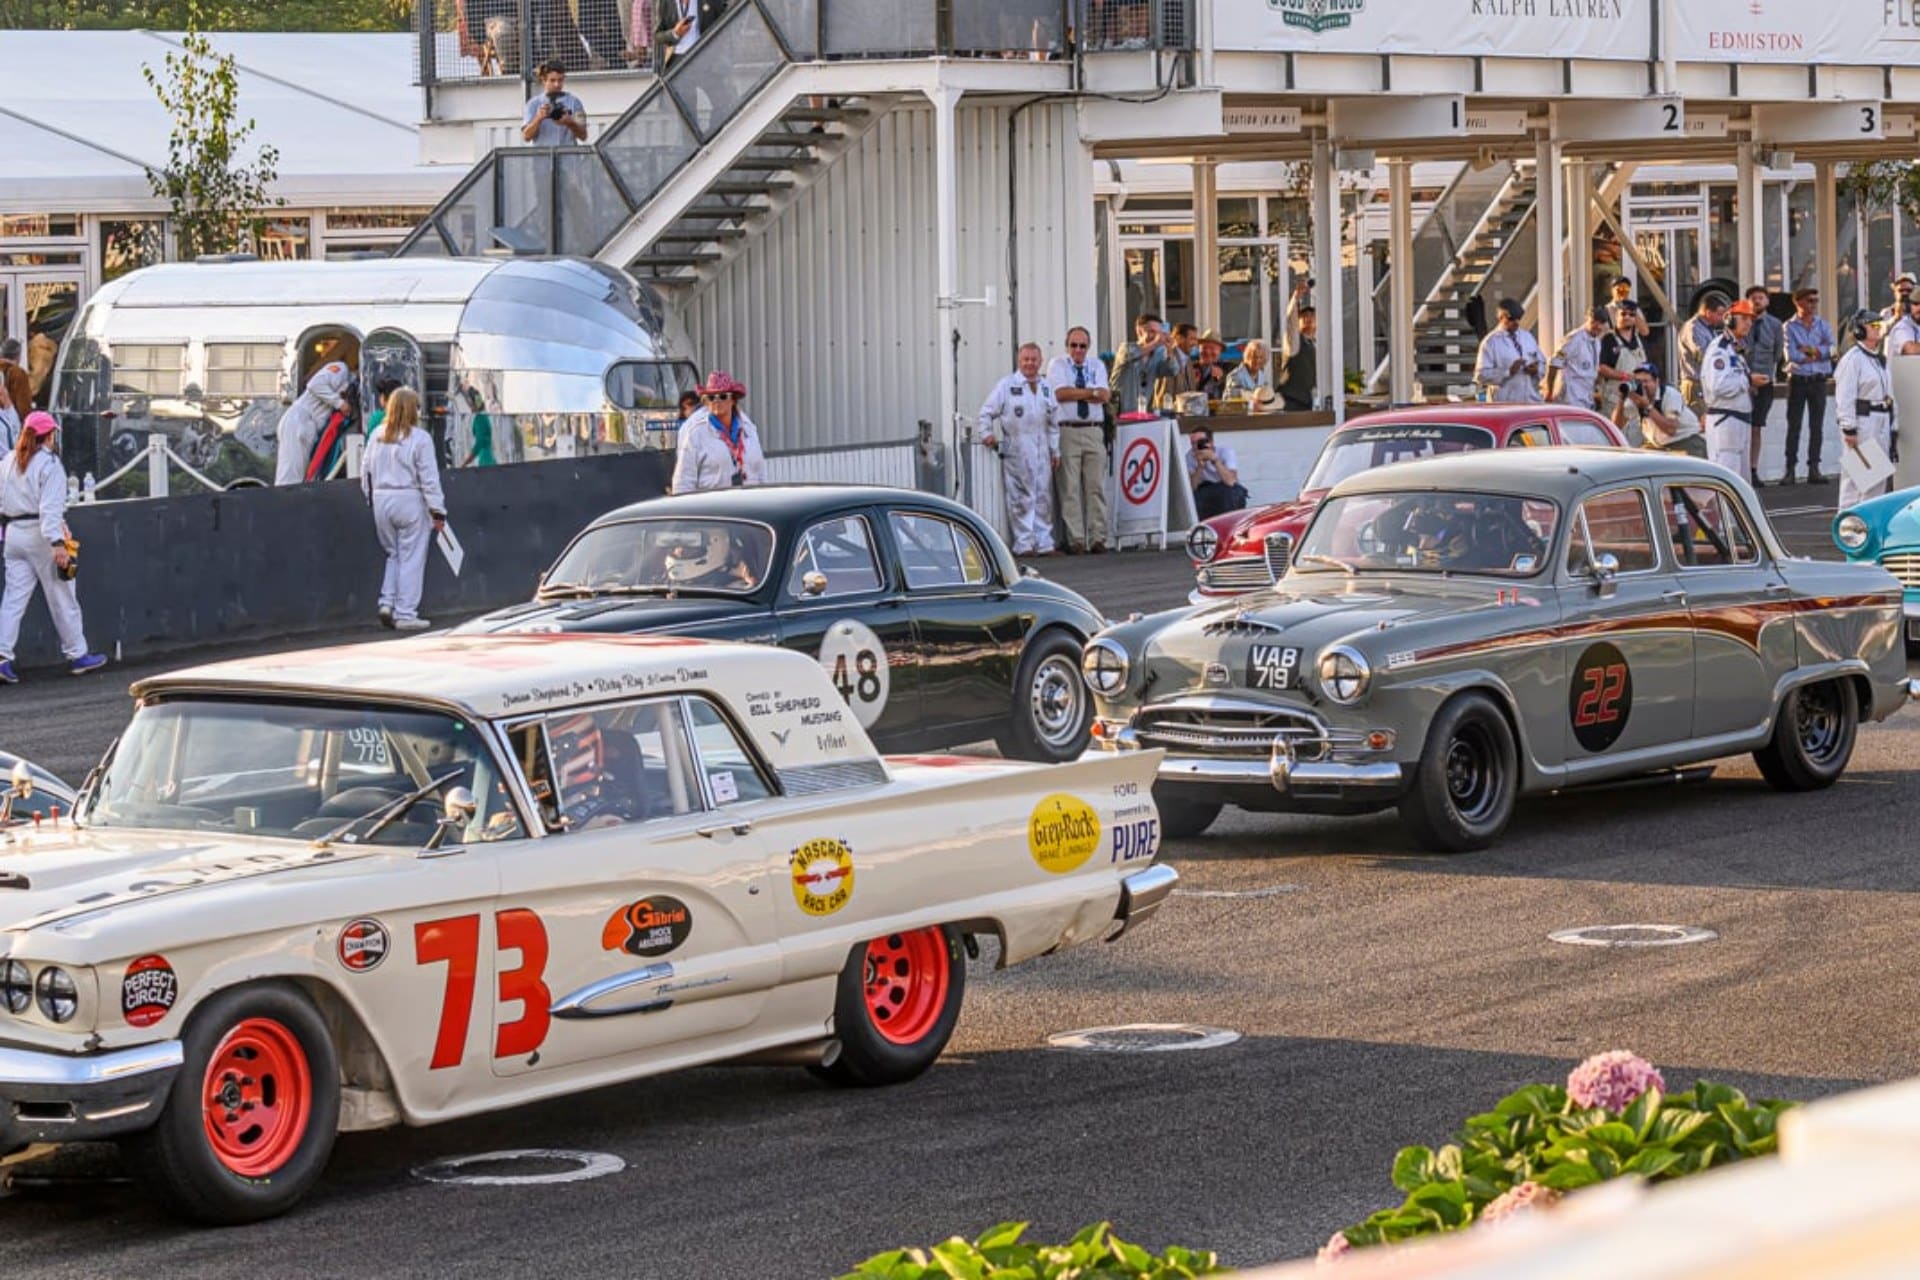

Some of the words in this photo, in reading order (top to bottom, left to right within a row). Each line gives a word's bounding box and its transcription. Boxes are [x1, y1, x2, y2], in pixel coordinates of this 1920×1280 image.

[1472, 0, 1536, 16] RALPH
[1549, 0, 1622, 19] LAUREN
[1709, 31, 1804, 50] EDMISTON
[1662, 103, 1680, 131] 2
[1860, 106, 1875, 133] 3
[1128, 458, 1154, 484] 20
[1252, 645, 1298, 668] VAB
[832, 649, 881, 707] 48
[1254, 666, 1290, 689] 719
[750, 704, 772, 716] BILL
[774, 697, 822, 712] SHEPHERD
[1575, 663, 1627, 727] 22
[801, 710, 842, 725] MUSTANG
[353, 743, 386, 763] 779
[1113, 783, 1137, 797] FORD
[1111, 819, 1157, 863] PURE
[797, 840, 843, 870] NASCAR
[630, 901, 685, 929] Gabriel
[124, 970, 174, 995] PERFECT
[413, 908, 552, 1071] 73
[126, 987, 174, 1009] CIRCLE
